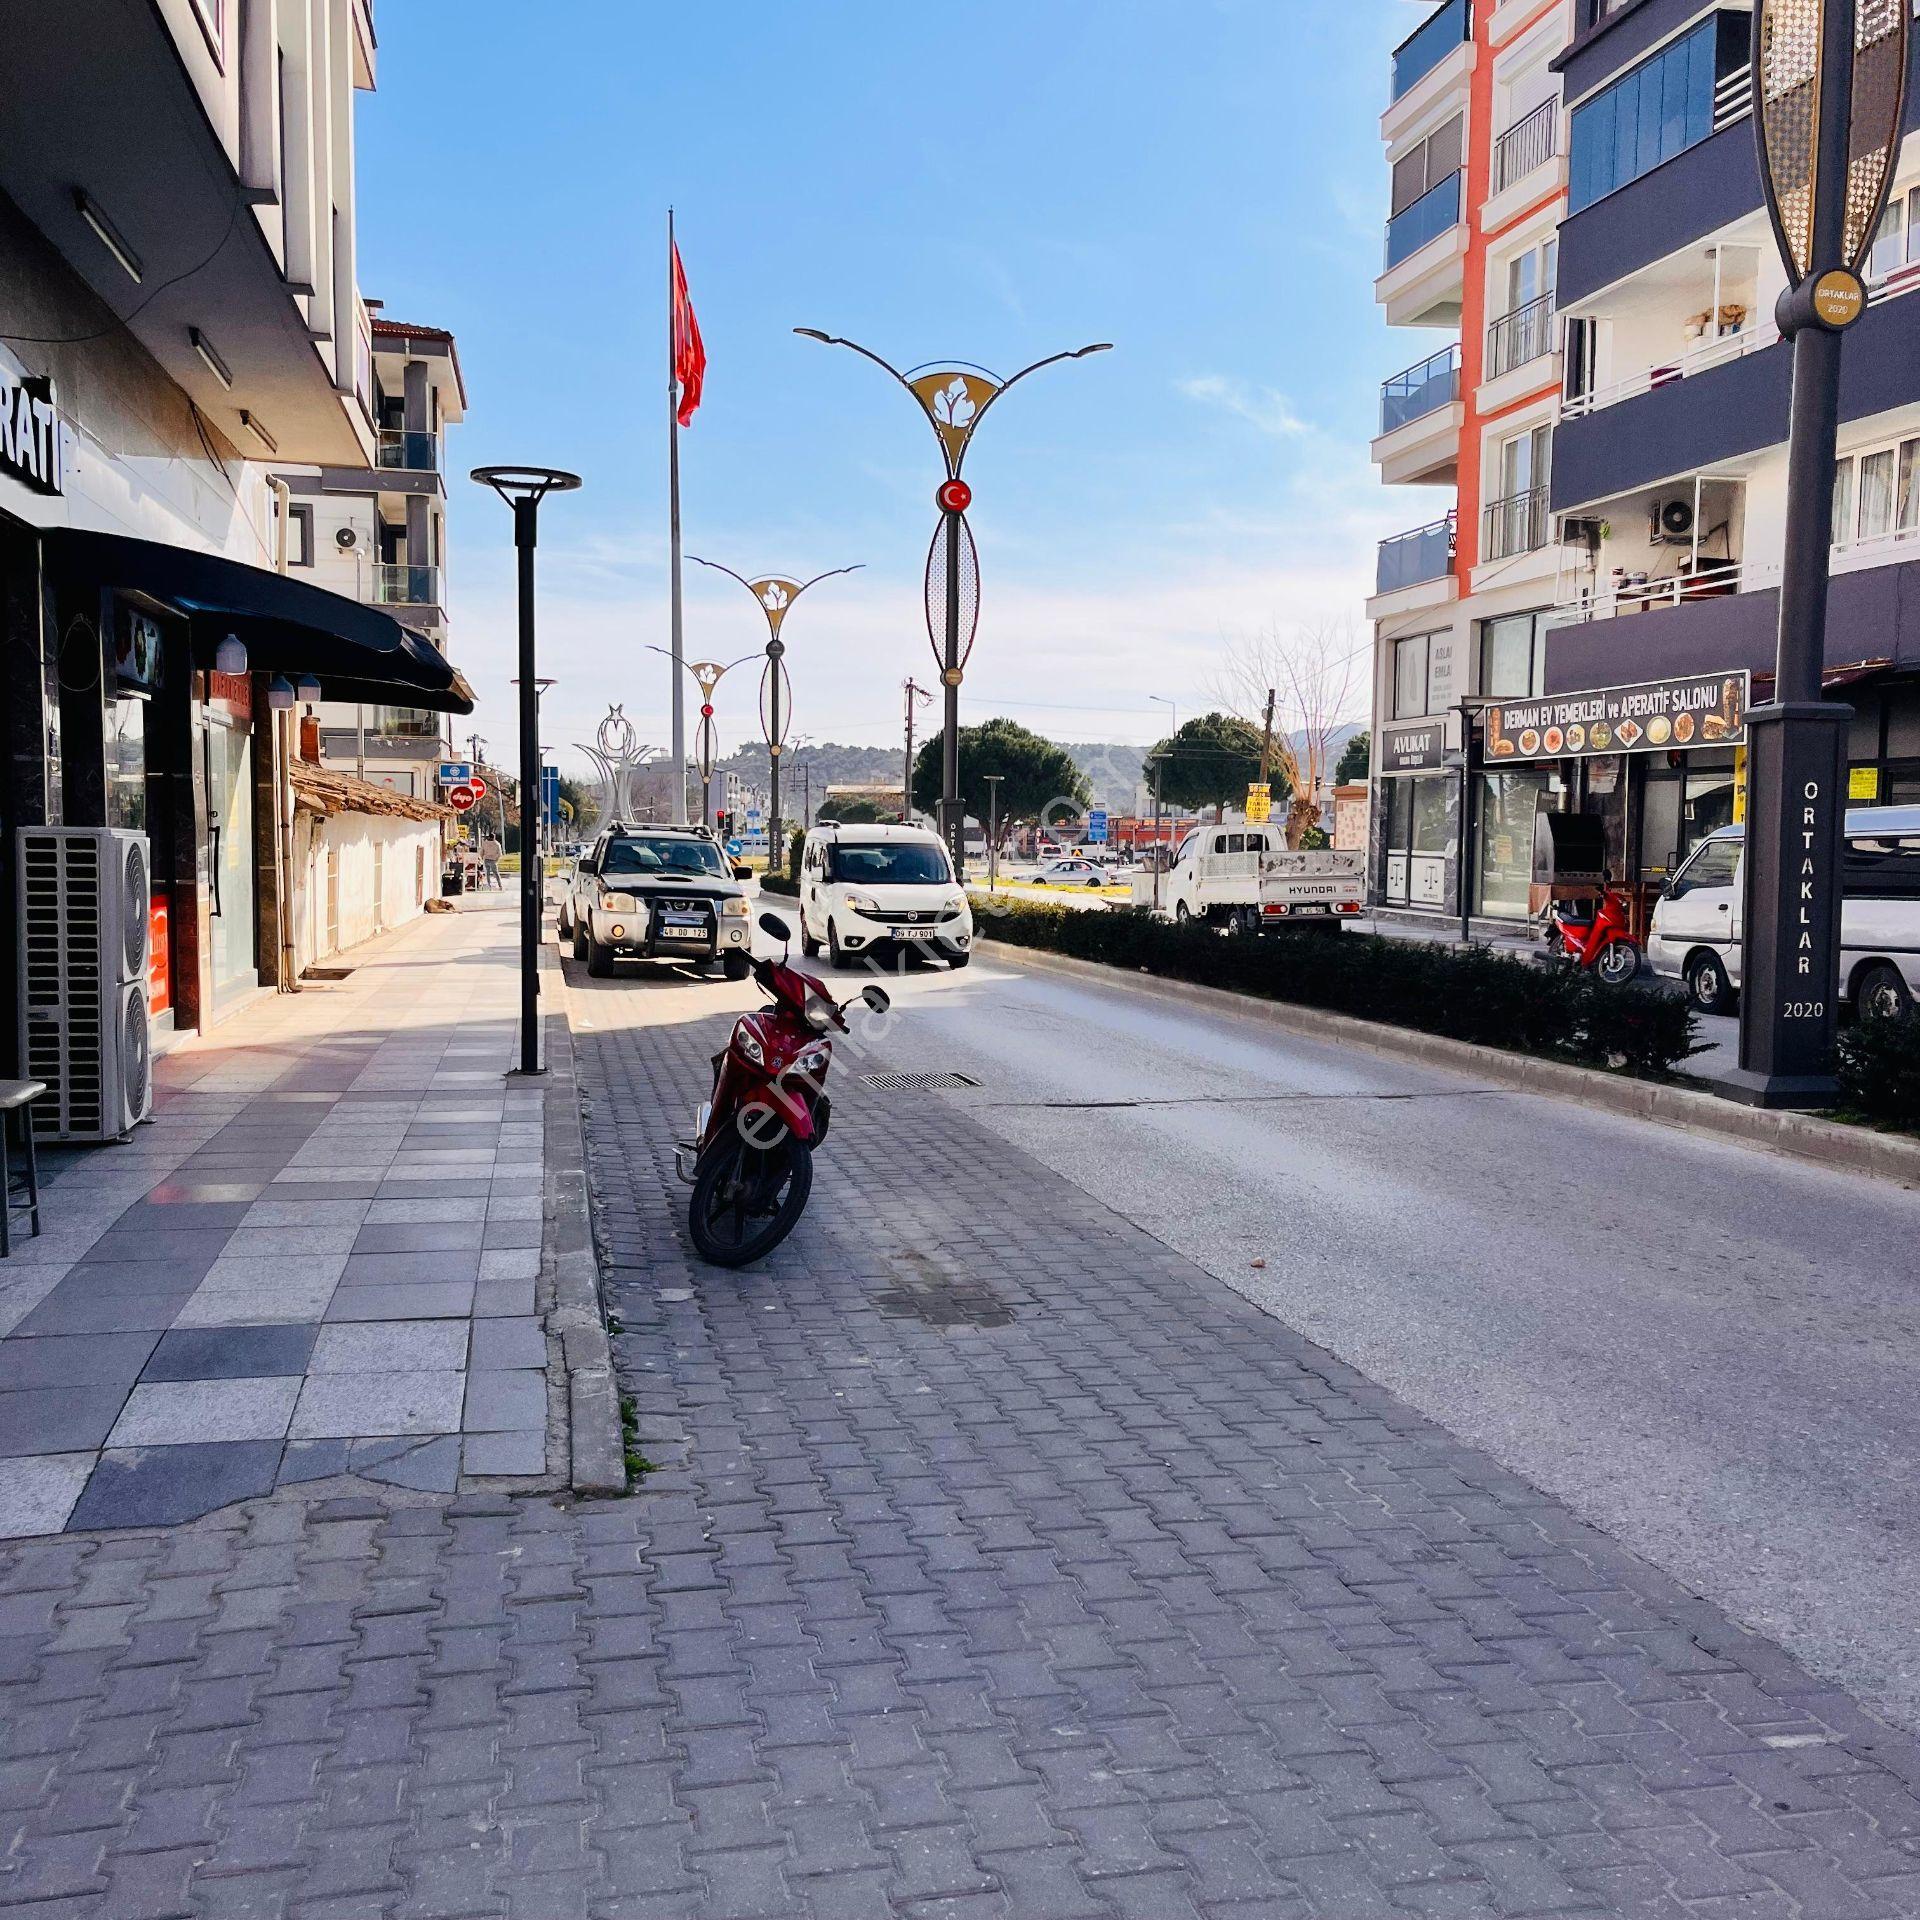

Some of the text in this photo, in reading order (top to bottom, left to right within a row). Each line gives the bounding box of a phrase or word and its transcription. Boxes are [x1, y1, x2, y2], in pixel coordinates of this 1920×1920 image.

[1818, 288, 1859, 301] ORTAKLAR
[1827, 304, 1848, 315] 2020
[1504, 685, 1718, 730] DERMAN EV YEMEKLERİ ve APERATİF SALONU
[1393, 733, 1431, 754] AVUKAT
[452, 792, 472, 804] dyo
[1797, 781, 1819, 975] ORTAKLAR
[1289, 885, 1337, 894] HYUNDAI
[1783, 1002, 1824, 1019] 2020
